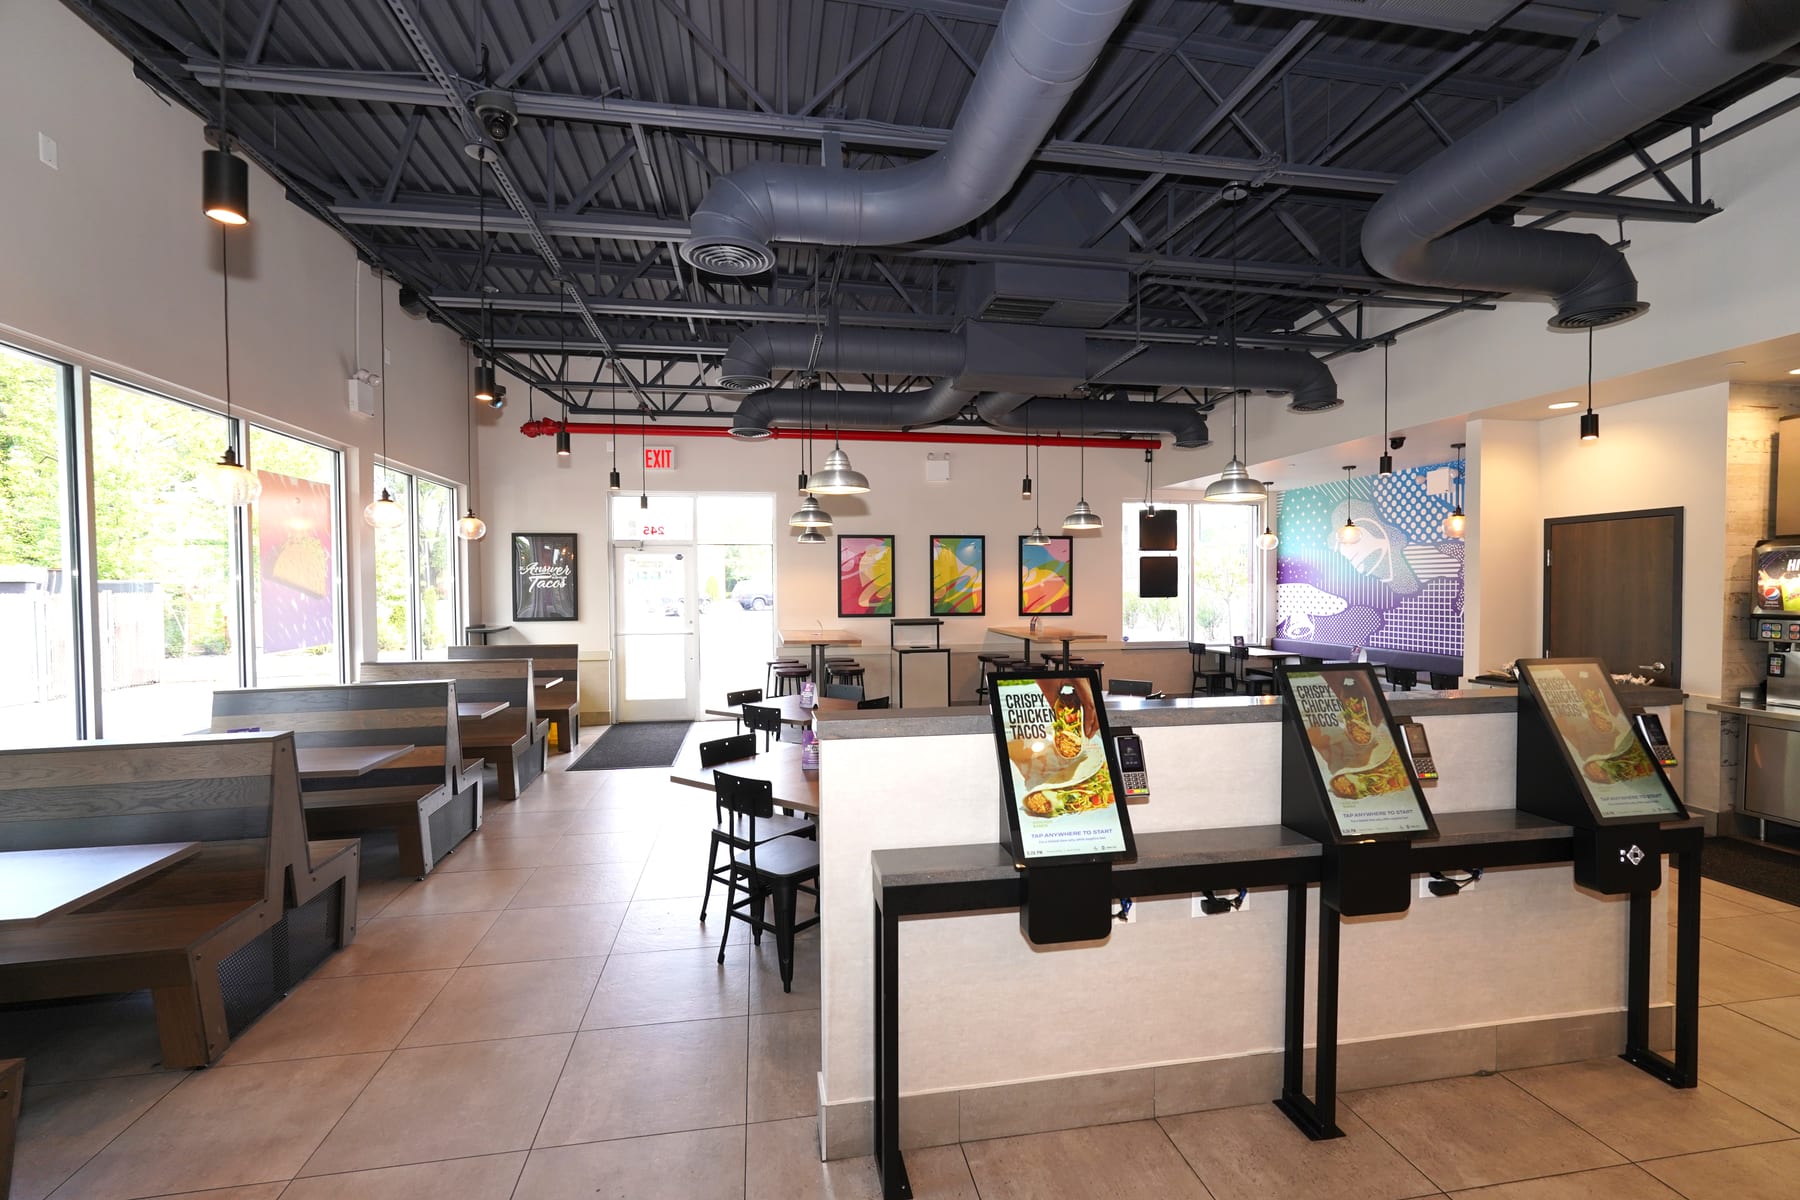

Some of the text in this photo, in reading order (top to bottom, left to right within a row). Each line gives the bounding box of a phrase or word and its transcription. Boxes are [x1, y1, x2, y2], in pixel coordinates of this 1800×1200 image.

[645, 449, 672, 468] EXIT
[519, 561, 571, 576] Answer
[528, 573, 567, 593] Tacos
[1296, 685, 1332, 699] CRISPY
[1005, 693, 1045, 709] CRISPY
[1301, 698, 1345, 713] CHICKEN
[1008, 708, 1057, 724] CHICKEN
[1305, 713, 1339, 728] TACOS
[1009, 724, 1047, 740] TACOS
